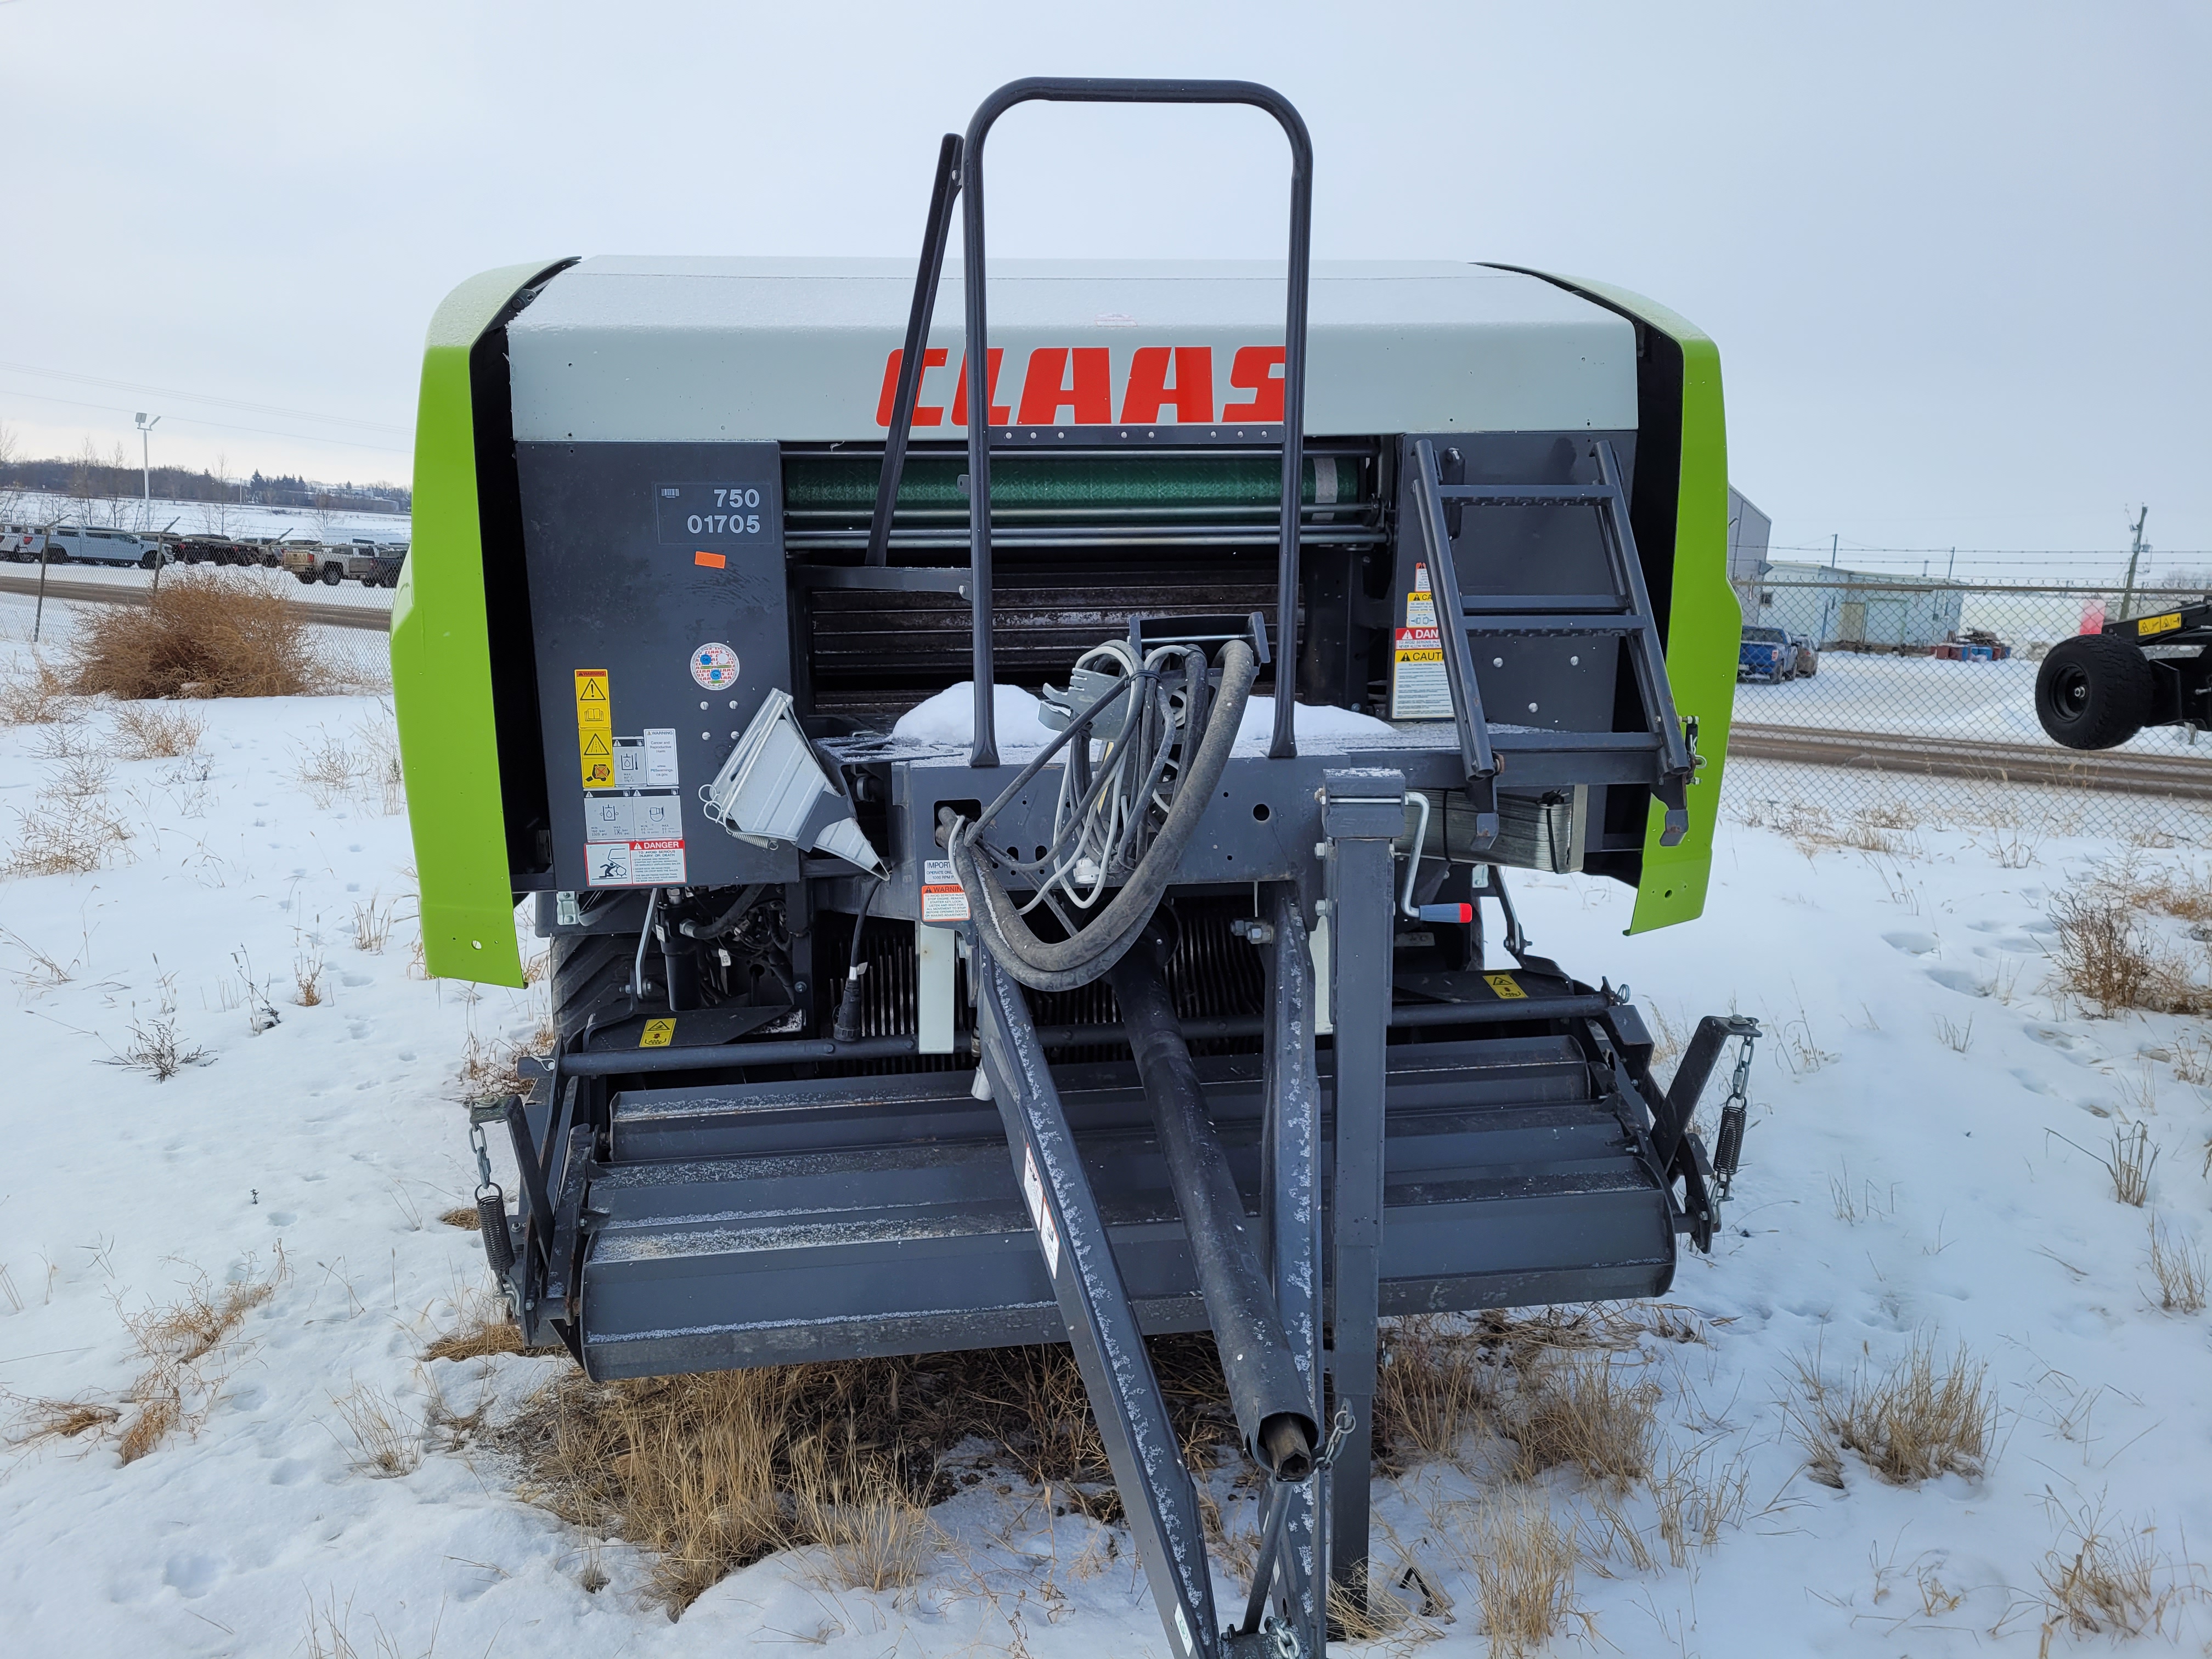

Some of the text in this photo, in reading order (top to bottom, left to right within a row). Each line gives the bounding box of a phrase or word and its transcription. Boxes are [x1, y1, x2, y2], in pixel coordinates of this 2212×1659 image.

[875, 346, 1286, 427] CLAAS
[714, 489, 760, 509] 750
[687, 514, 760, 534] 01705
[1416, 629, 1439, 638] DAN
[1413, 652, 1444, 660] CAUTI
